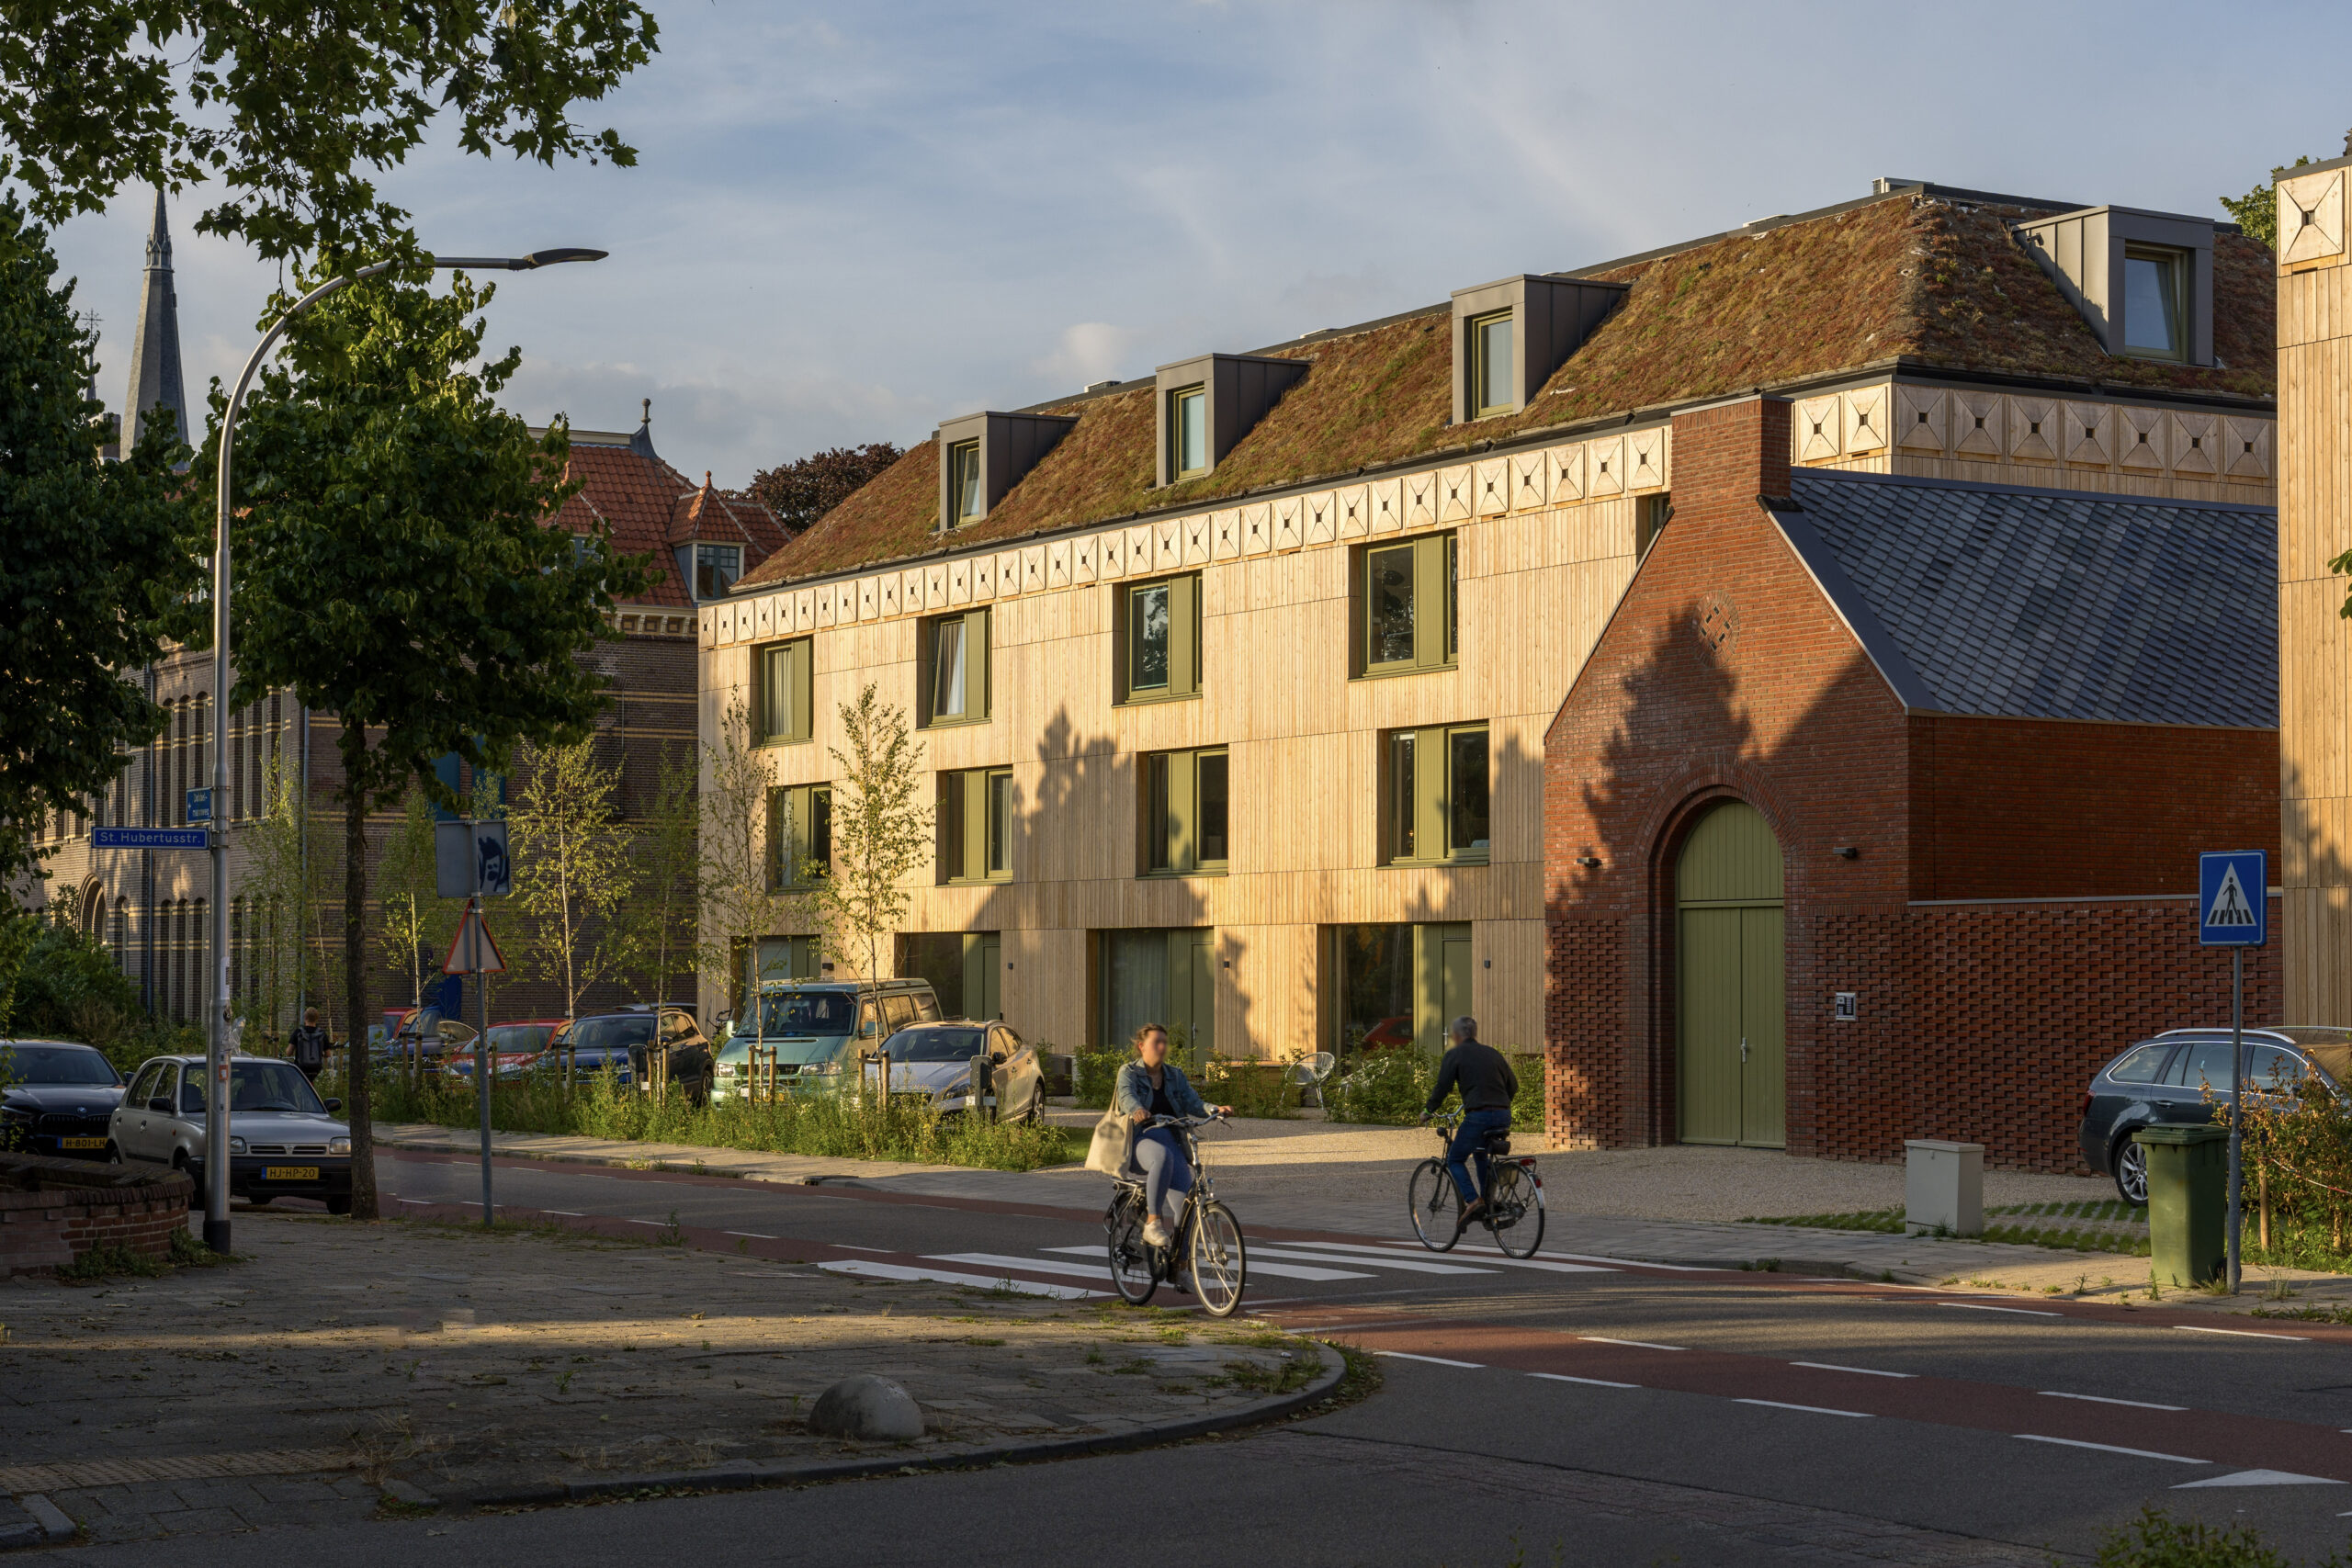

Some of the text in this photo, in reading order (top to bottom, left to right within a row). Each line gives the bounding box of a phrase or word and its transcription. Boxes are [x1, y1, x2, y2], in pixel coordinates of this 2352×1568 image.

[100, 831, 201, 843] St. Hubertusstr.
[270, 1168, 315, 1178] HJ-HP-20
